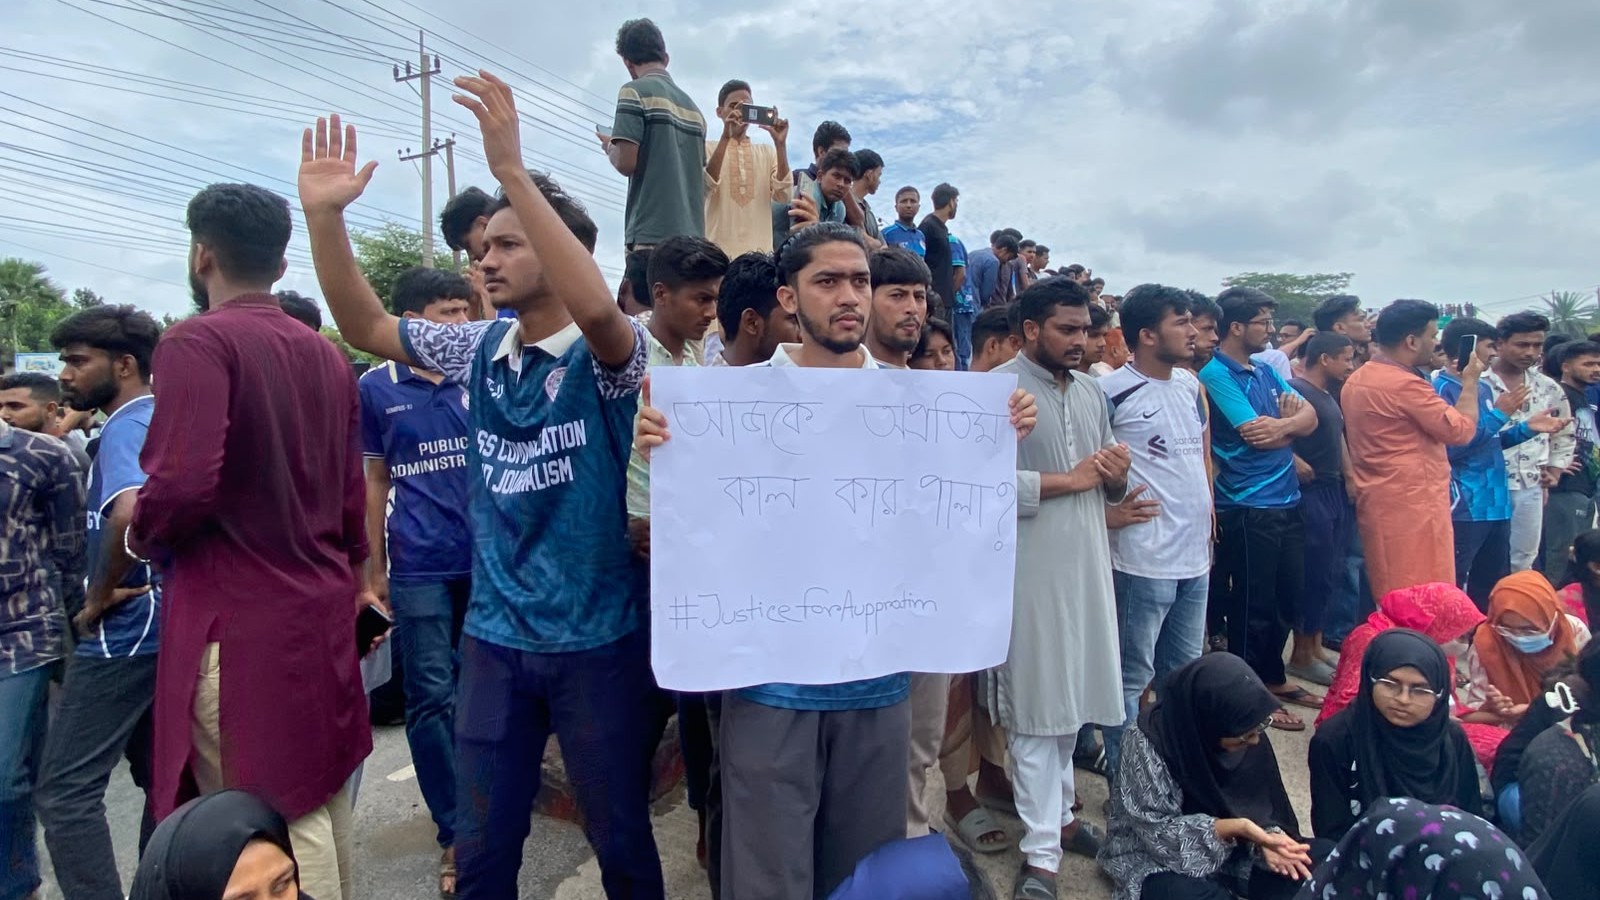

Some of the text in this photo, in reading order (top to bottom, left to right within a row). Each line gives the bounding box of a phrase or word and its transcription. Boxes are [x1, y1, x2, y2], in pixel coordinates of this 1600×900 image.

[418, 436, 469, 457] PUBLIC
[672, 398, 824, 456] আজকে
[717, 476, 811, 516] কাল
[833, 477, 905, 527] কার
